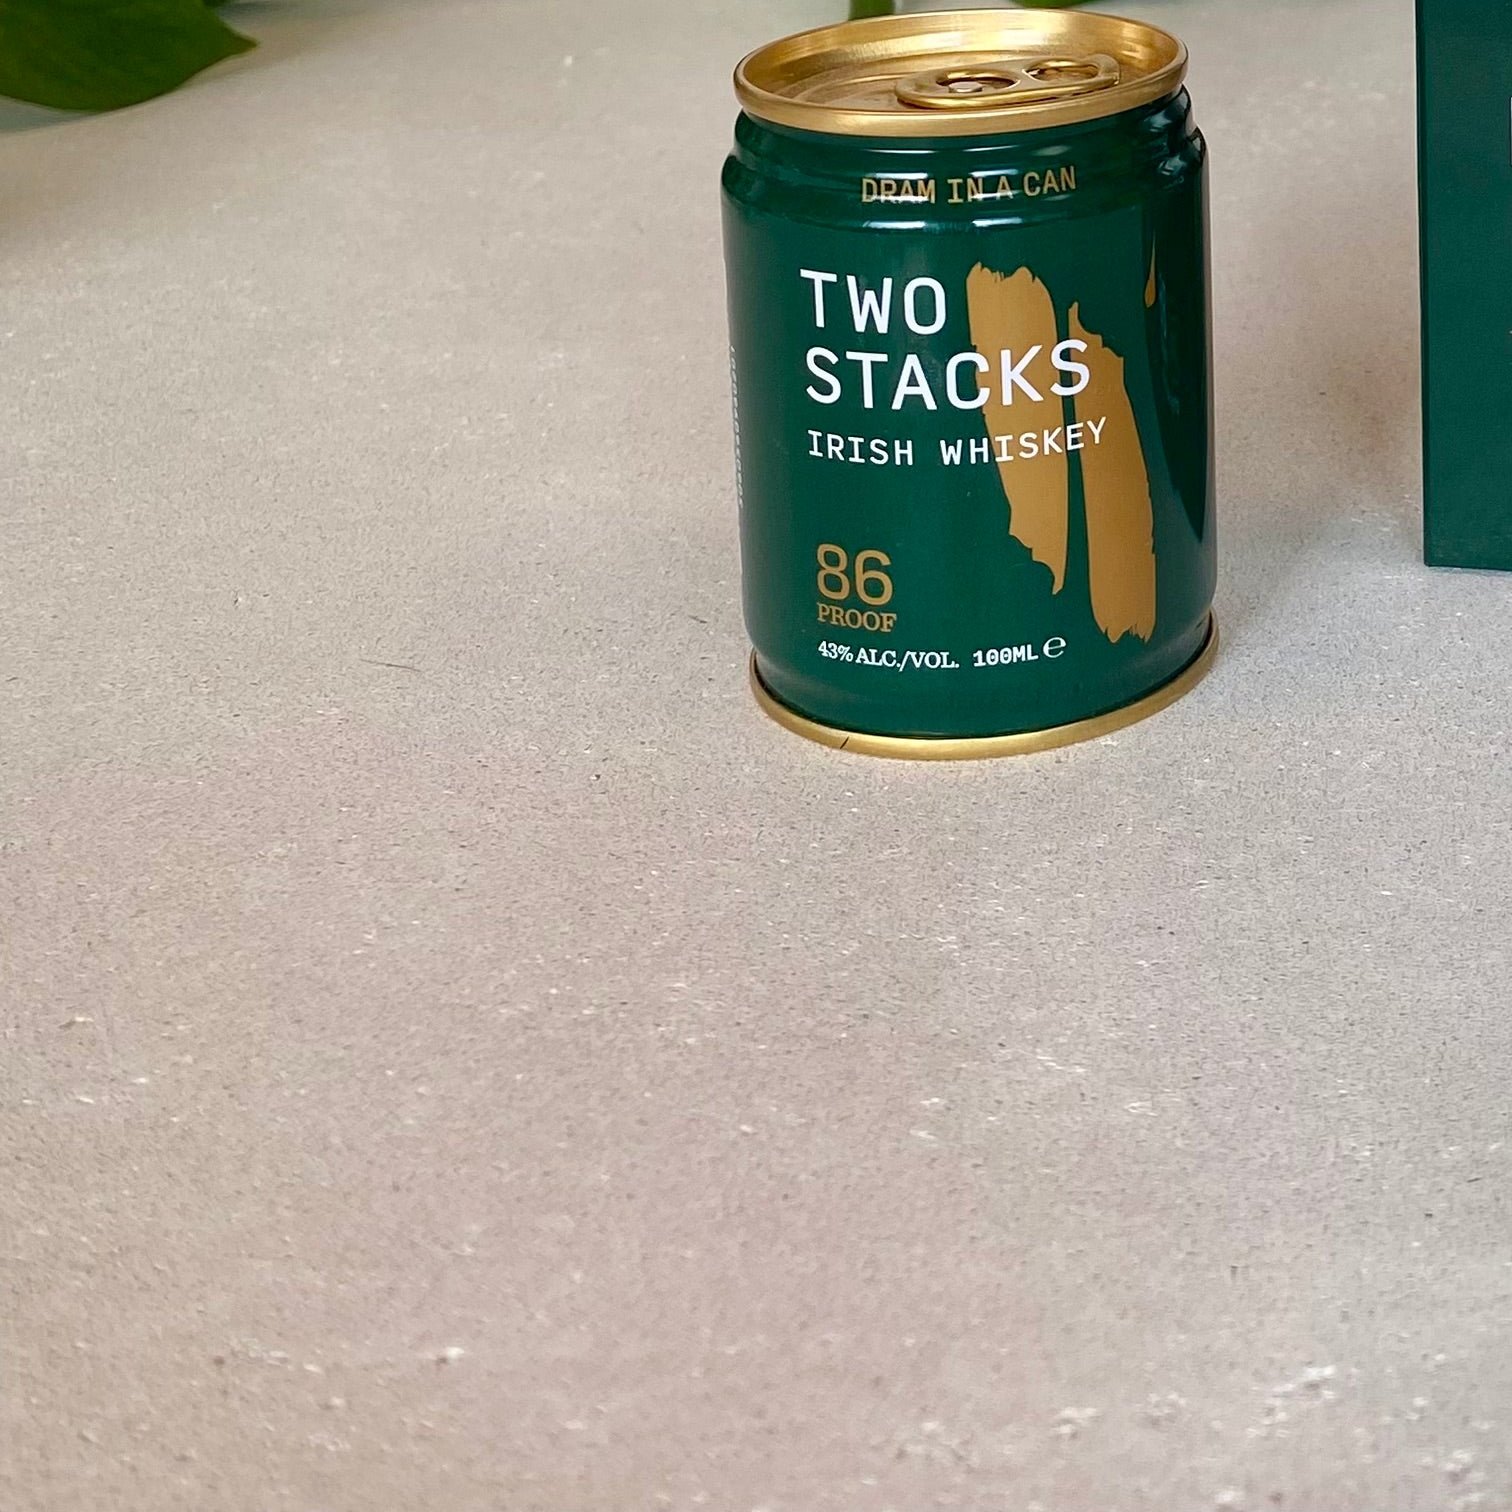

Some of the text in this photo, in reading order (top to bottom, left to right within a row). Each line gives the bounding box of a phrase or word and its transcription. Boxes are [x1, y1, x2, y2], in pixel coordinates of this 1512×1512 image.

[861, 165, 1076, 204] DRAM IN A CAN
[799, 268, 946, 335] TWO
[805, 339, 1091, 410] STACKS
[807, 417, 1107, 466] IRISH WHISKEY
[816, 543, 893, 606] 86
[816, 602, 897, 633] PROOF
[972, 644, 1039, 667] 100ML
